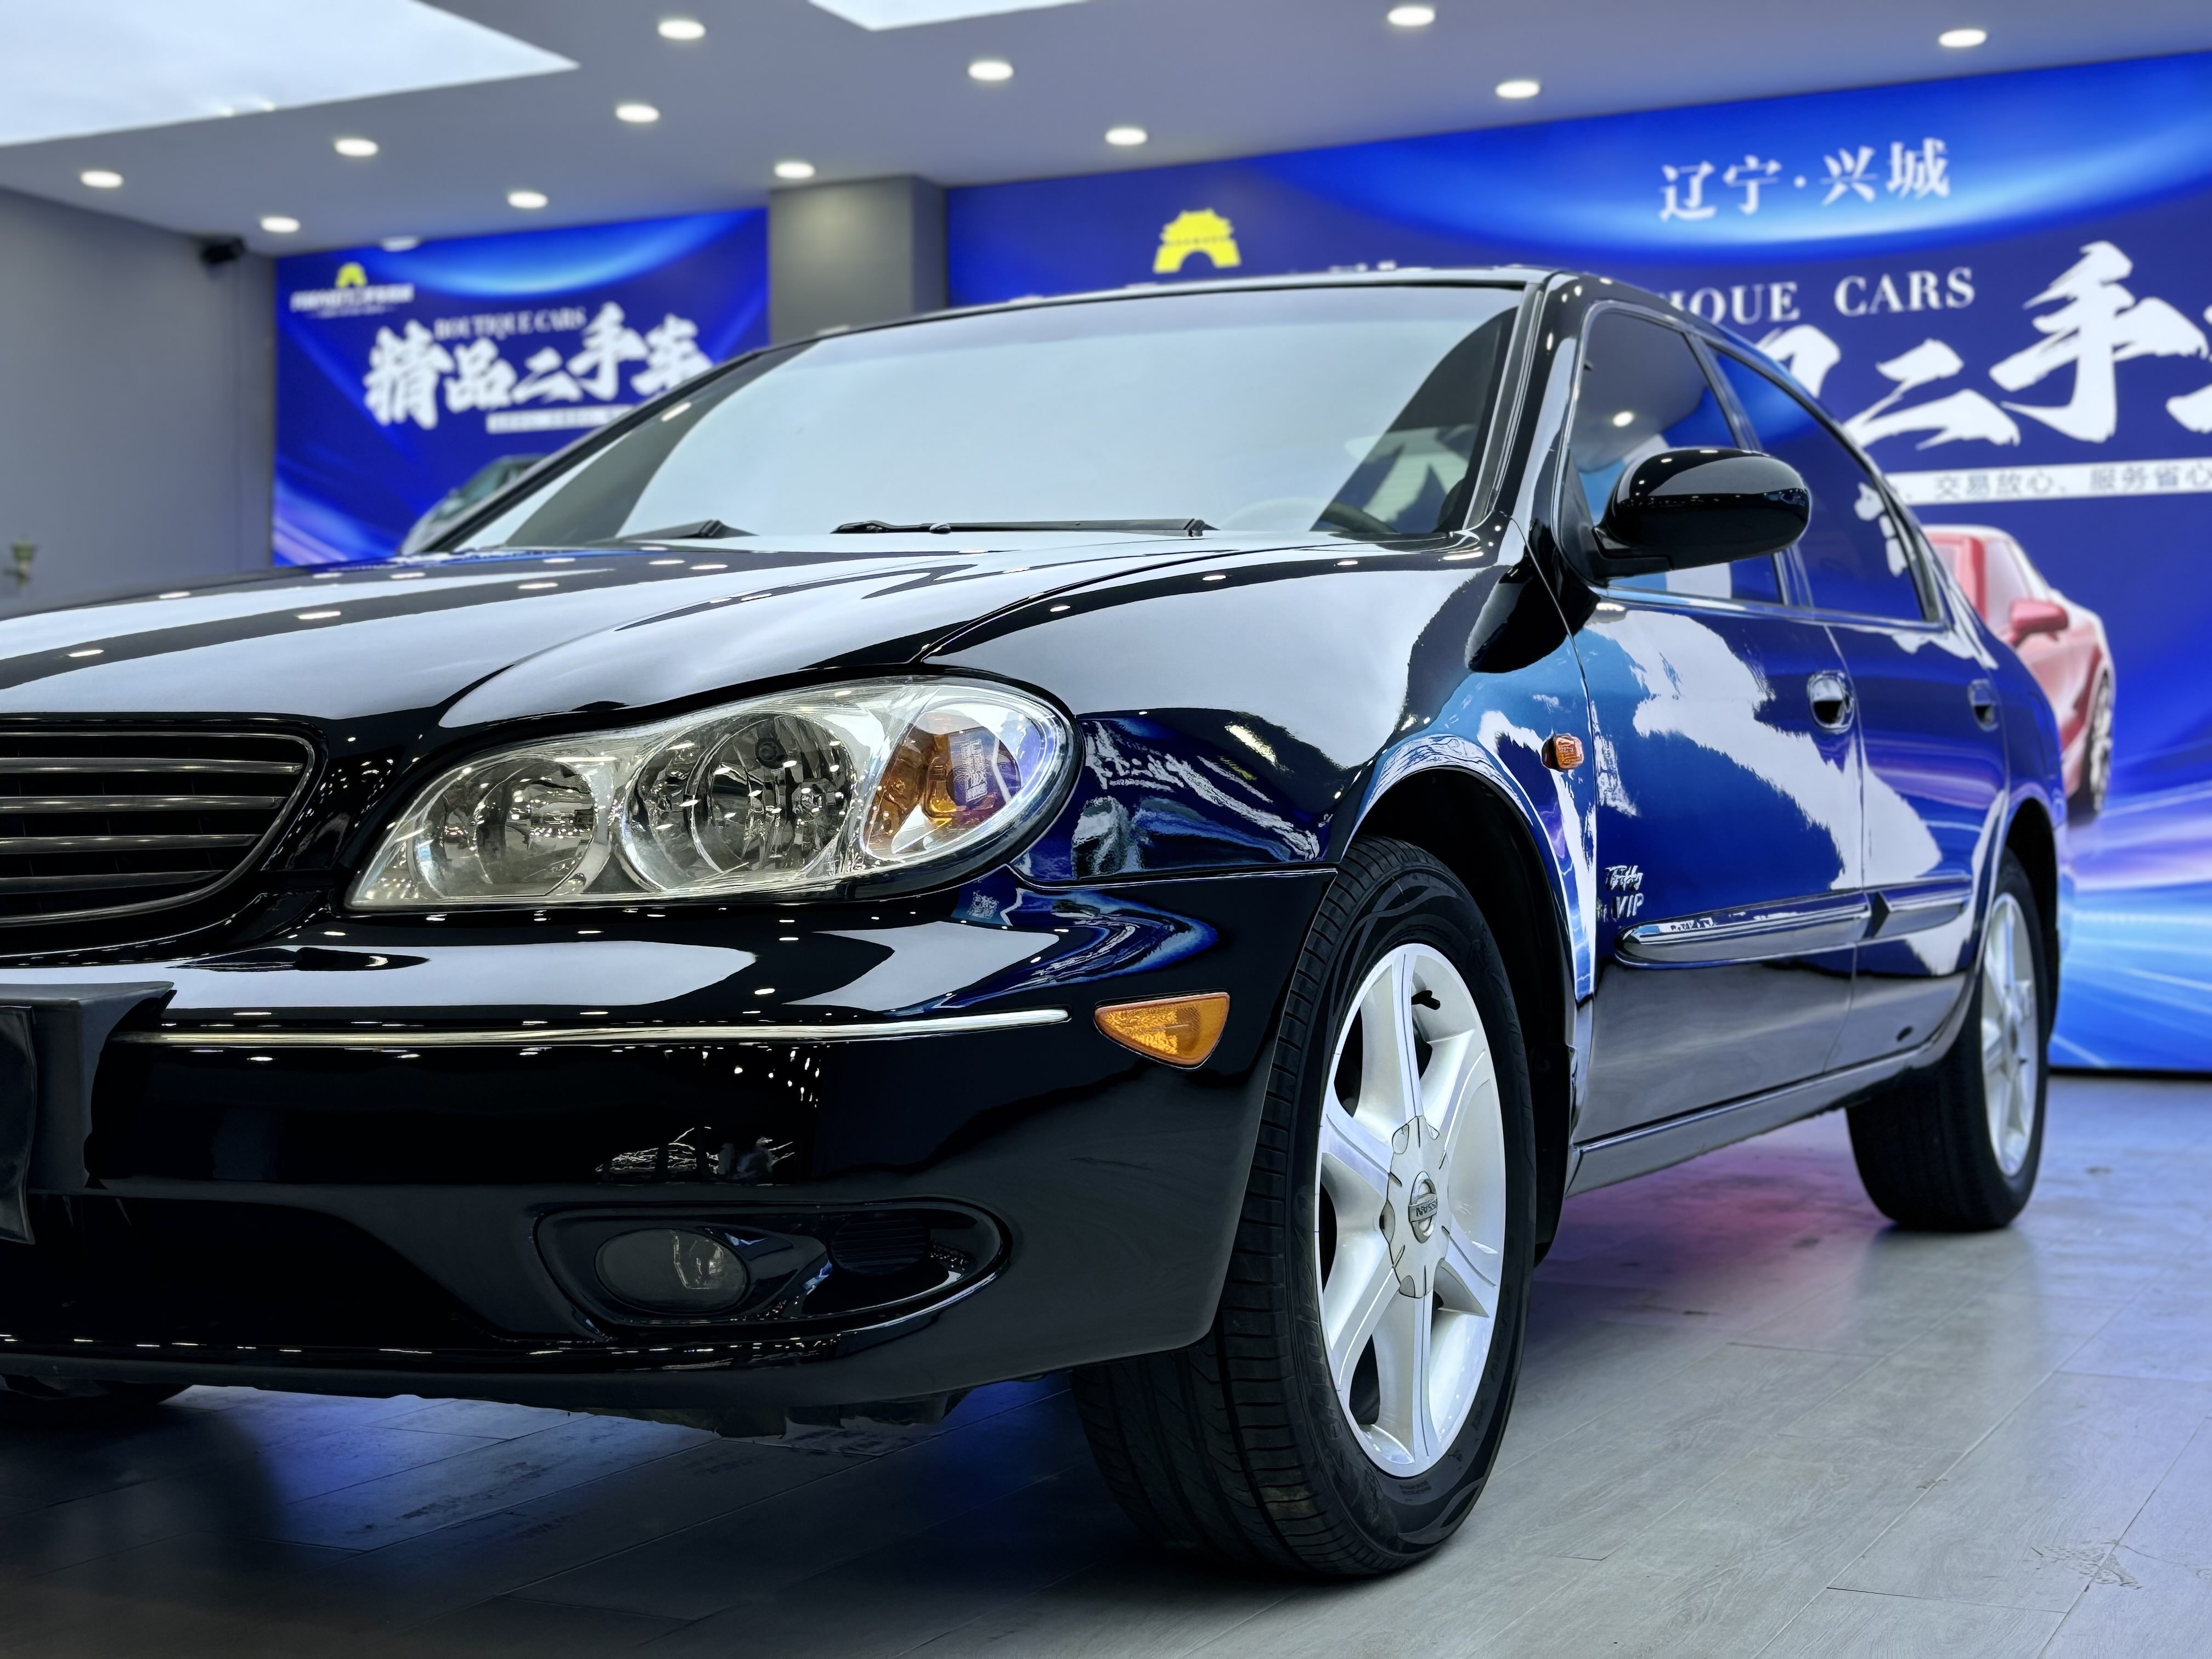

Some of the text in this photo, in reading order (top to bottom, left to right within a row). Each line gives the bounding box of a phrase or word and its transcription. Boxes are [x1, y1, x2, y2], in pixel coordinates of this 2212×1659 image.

[1659, 137, 1951, 222] 辽宁·兴城
[1833, 266, 1976, 317] CARS
[363, 300, 714, 430] 精品二手车
[1756, 240, 2212, 451] 二手
